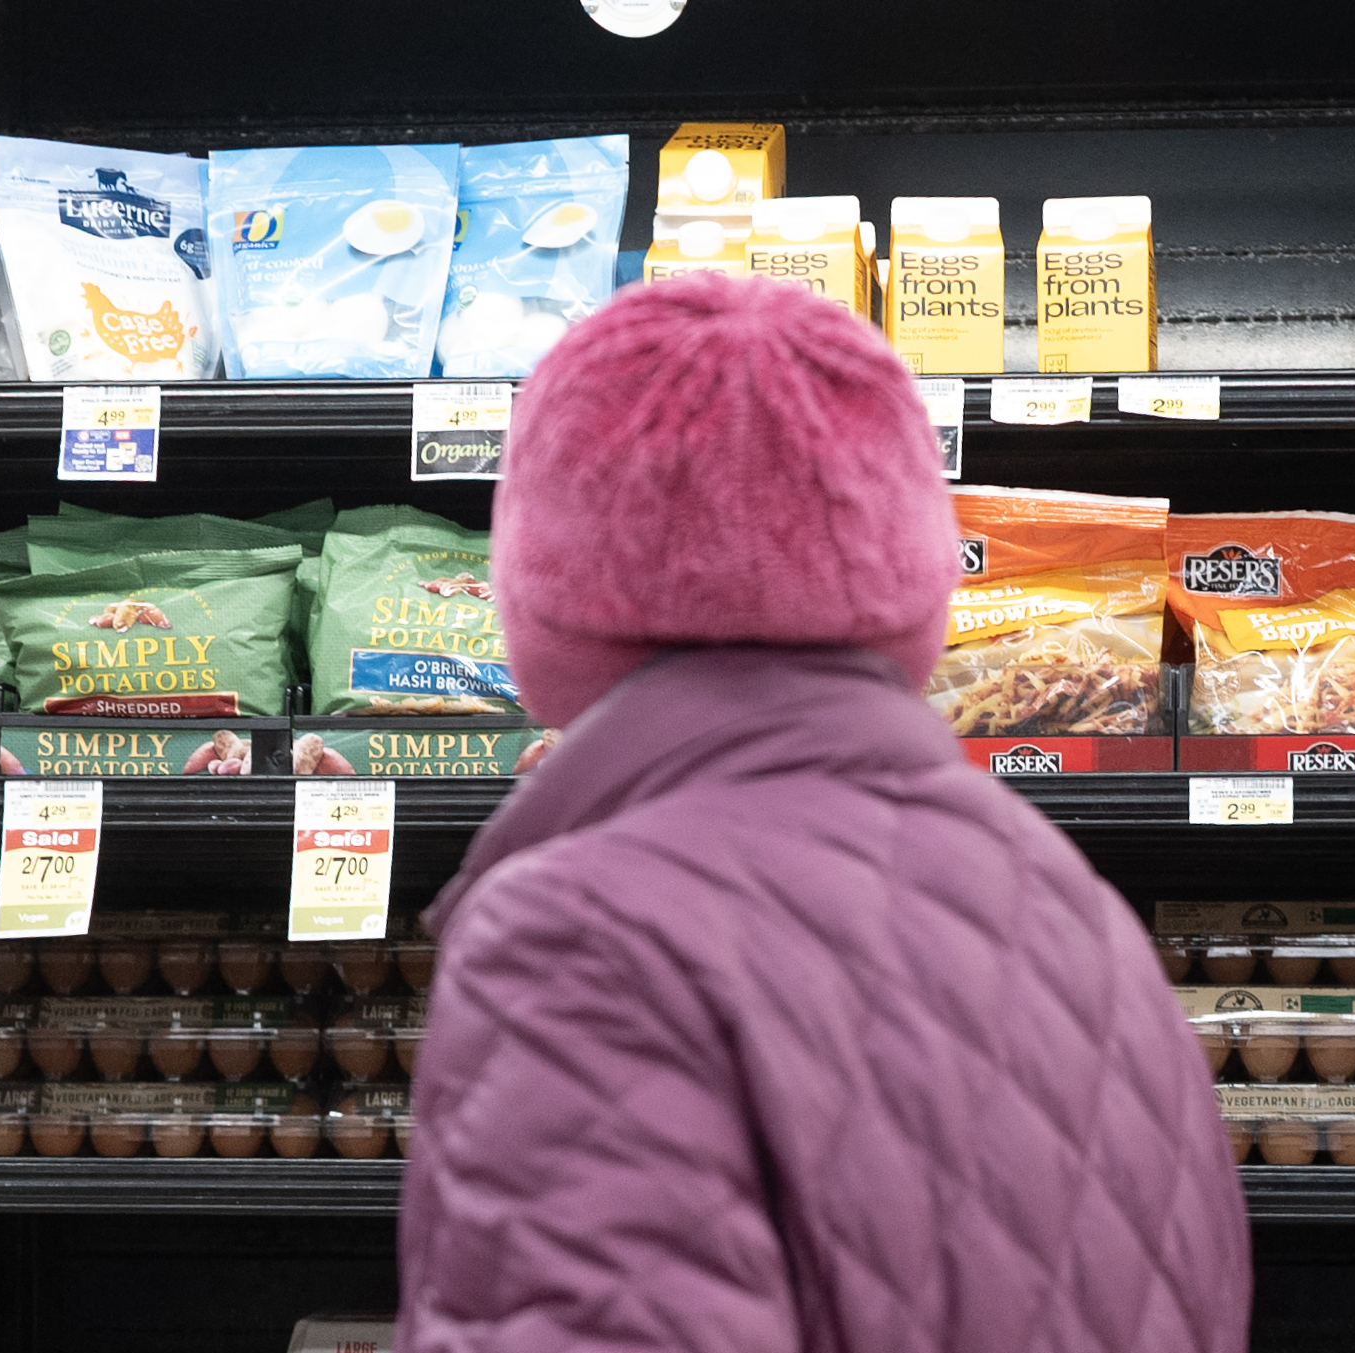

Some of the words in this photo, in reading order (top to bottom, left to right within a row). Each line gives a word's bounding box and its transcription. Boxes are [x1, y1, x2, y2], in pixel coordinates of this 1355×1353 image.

[65, 196, 165, 228] Lucerne
[751, 251, 828, 276] Eggs
[900, 251, 979, 276] Eggs
[1044, 251, 1123, 276] Eggs
[900, 274, 976, 296] from
[1044, 274, 1120, 296] from
[900, 297, 999, 321] plants
[1044, 297, 1143, 321] plants
[101, 313, 164, 335] Cage
[126, 331, 178, 355] Free
[421, 440, 501, 464] Organic
[1190, 557, 1275, 589] RESER'S
[371, 596, 505, 635] SIMPL
[956, 598, 1061, 633] Browns
[1247, 607, 1320, 628] Hash
[51, 635, 216, 671] SIMPLY
[369, 627, 507, 657] POTATOE
[414, 660, 476, 677] O'BRIEN
[59, 668, 216, 694] POTATOES
[389, 674, 432, 690] HASH
[437, 675, 502, 696] BROWNS
[96, 700, 181, 714] SHREDDED
[37, 732, 172, 758] SIMPLY
[368, 733, 502, 758] SIMPLY
[37, 761, 168, 775] POTATOES
[369, 762, 499, 775] POTATOES
[994, 752, 1060, 772] RESER'S
[22, 831, 79, 846] Sale!
[314, 832, 371, 846] Sale!
[313, 916, 344, 926] Vegan
[365, 1092, 403, 1108] LARGE
[1223, 1093, 1297, 1110] VEGETARIAN
[1301, 1094, 1325, 1109] FED
